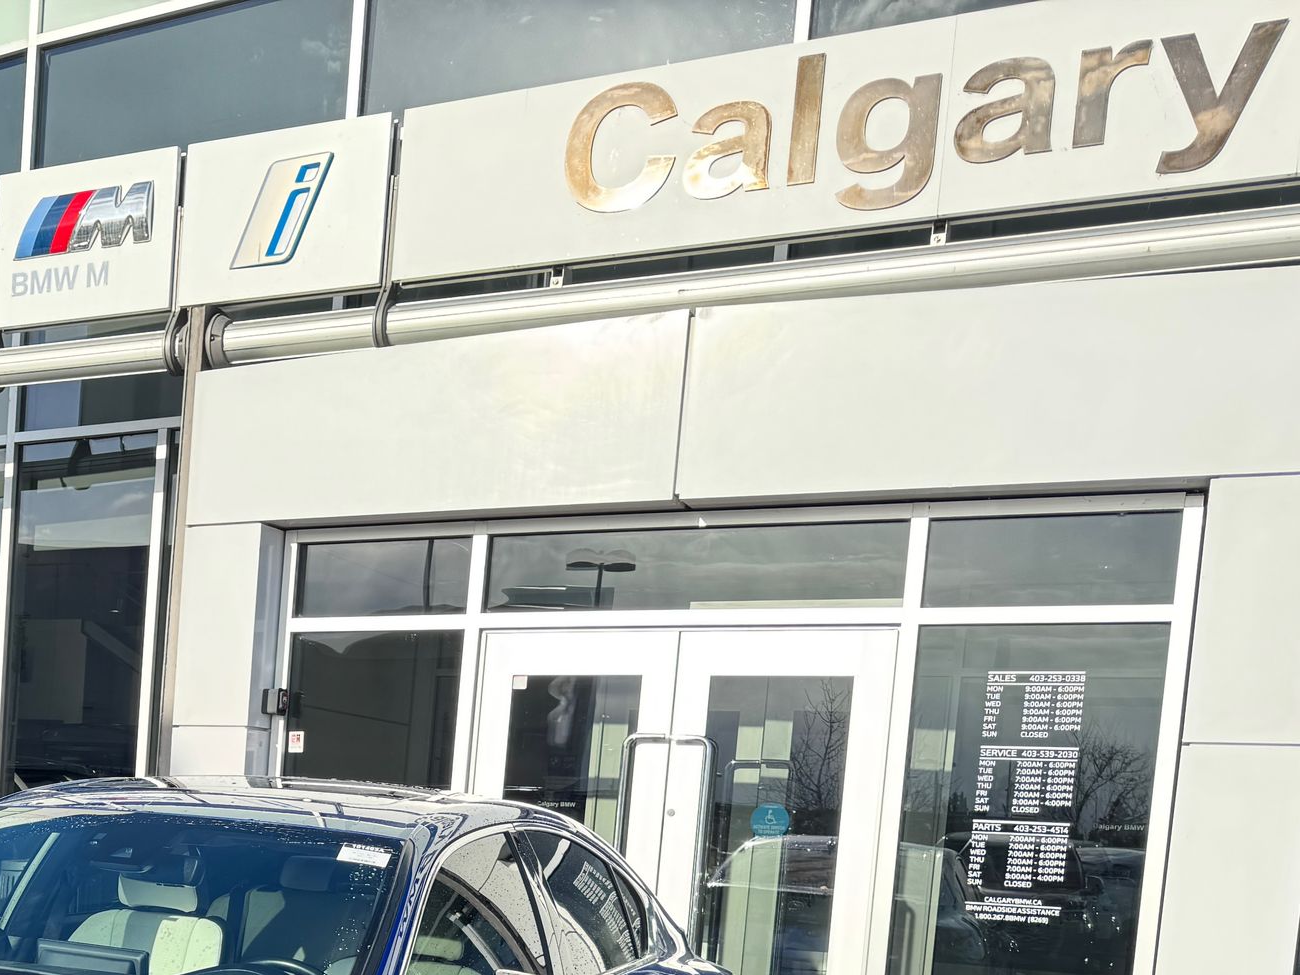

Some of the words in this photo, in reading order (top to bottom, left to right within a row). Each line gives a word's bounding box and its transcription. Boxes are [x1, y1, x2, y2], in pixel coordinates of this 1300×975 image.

[566, 18, 1290, 213] Calgary
[11, 266, 78, 297] BMW
[86, 260, 110, 287] M
[980, 749, 1018, 757] SERVICE
[1021, 750, 1078, 758] 403-539-2030
[972, 823, 1002, 831] PARTS
[1014, 825, 1069, 834] 403-253-4514
[1124, 824, 1145, 832] BMW
[984, 896, 1042, 906] CALGARYBMW.CA
[983, 906, 1016, 914] ROADSIDE
[1017, 907, 1060, 916] ASSISTANCE
